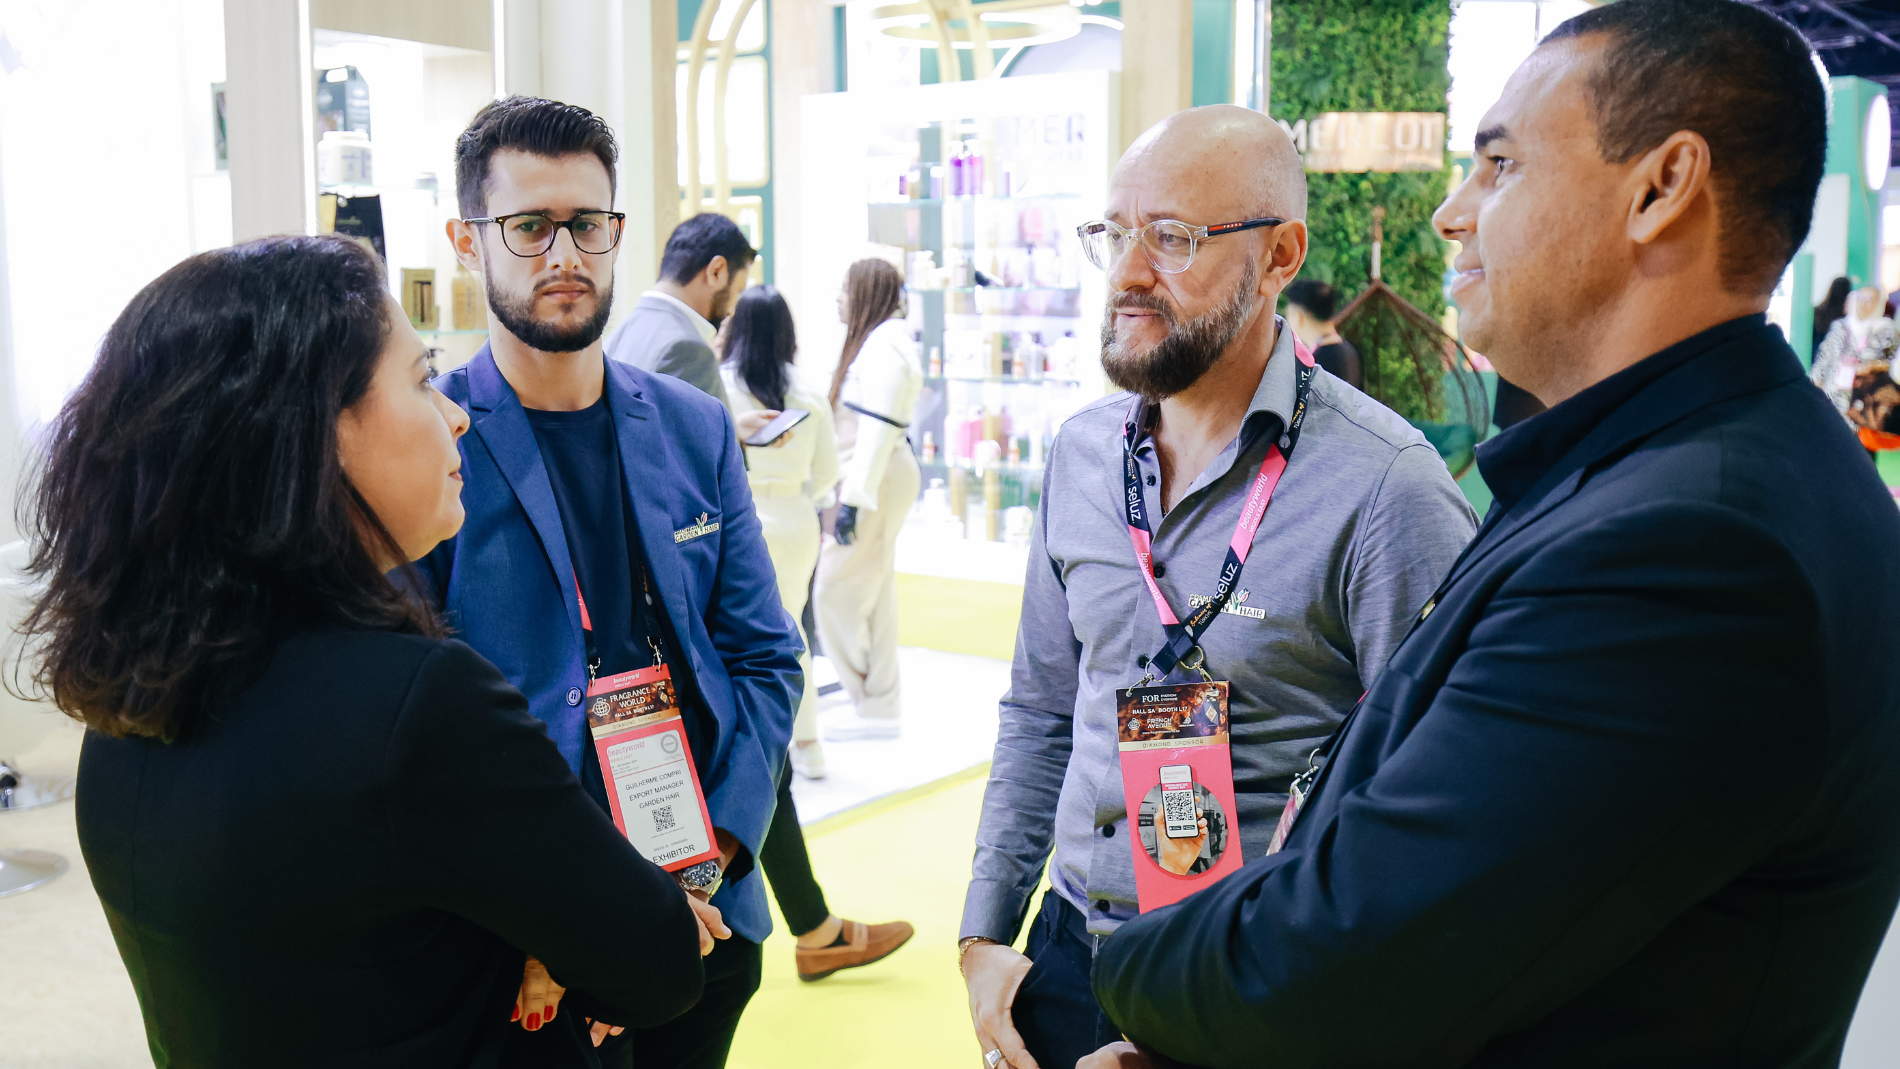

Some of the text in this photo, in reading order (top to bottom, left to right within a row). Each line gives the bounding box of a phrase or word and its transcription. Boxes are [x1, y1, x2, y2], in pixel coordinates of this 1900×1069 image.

[1240, 473, 1268, 530] beautyworld
[1249, 499, 1267, 533] MIDDLE EAST
[675, 523, 718, 542] GARDEN HAIR
[1239, 607, 1264, 618] HAIR
[610, 687, 650, 702] FRAGRANCE
[619, 697, 646, 708] WORLD
[1142, 694, 1160, 703] FOR
[626, 770, 681, 790] GUILHERME COMPRI
[629, 780, 684, 801] EXPORT MANAGER
[640, 792, 680, 809] GARDEN HAIR
[652, 844, 695, 864] EXHIBITOR
